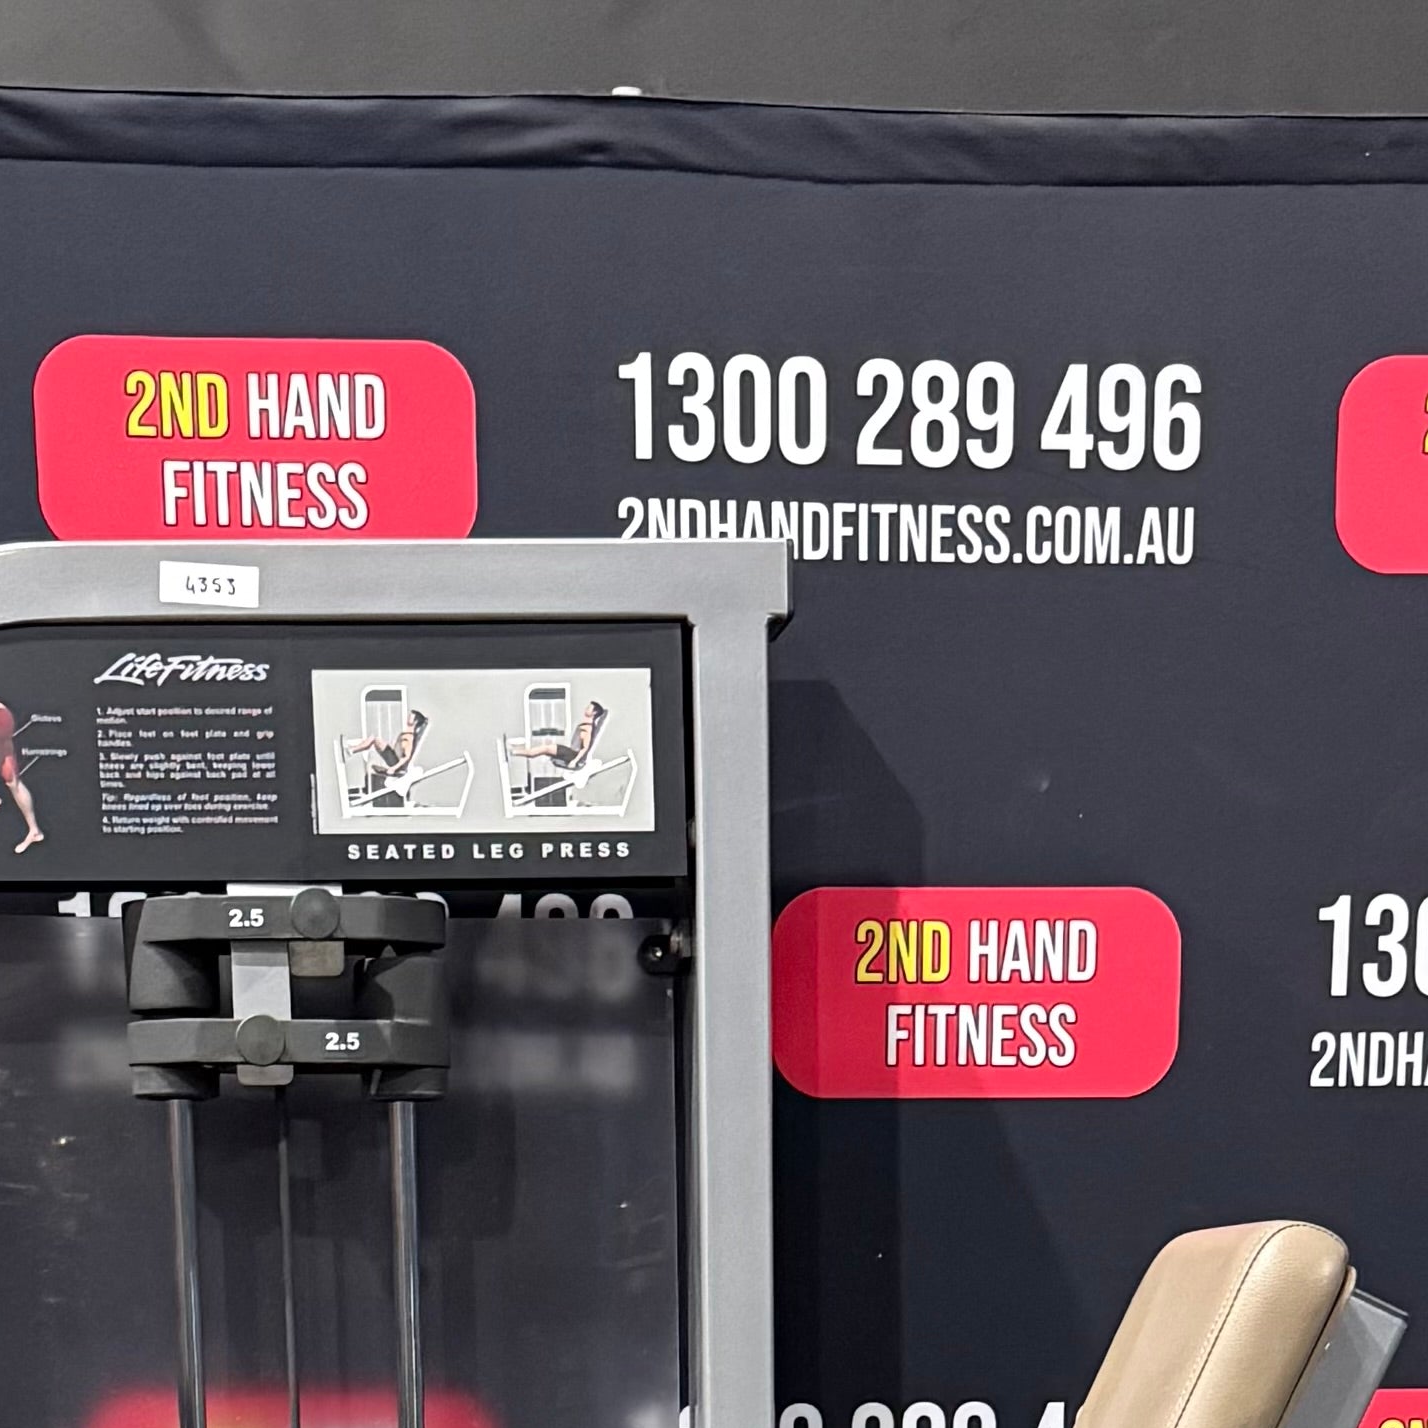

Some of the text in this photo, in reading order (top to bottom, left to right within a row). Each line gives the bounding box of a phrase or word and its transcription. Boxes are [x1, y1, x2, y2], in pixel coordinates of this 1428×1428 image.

[127, 371, 384, 438] 2ND HAND
[619, 352, 1201, 470] 1300 289 496
[164, 461, 367, 528] FITNESS
[616, 496, 1196, 564] 2NDHANDFITNESS.COM.AU
[348, 842, 629, 859] SEATED LEG PRESS
[229, 909, 263, 927] 2.5
[858, 921, 1096, 982] 2ND HAND
[326, 1032, 359, 1050] 2.5
[888, 1004, 1075, 1065] FITNESS
